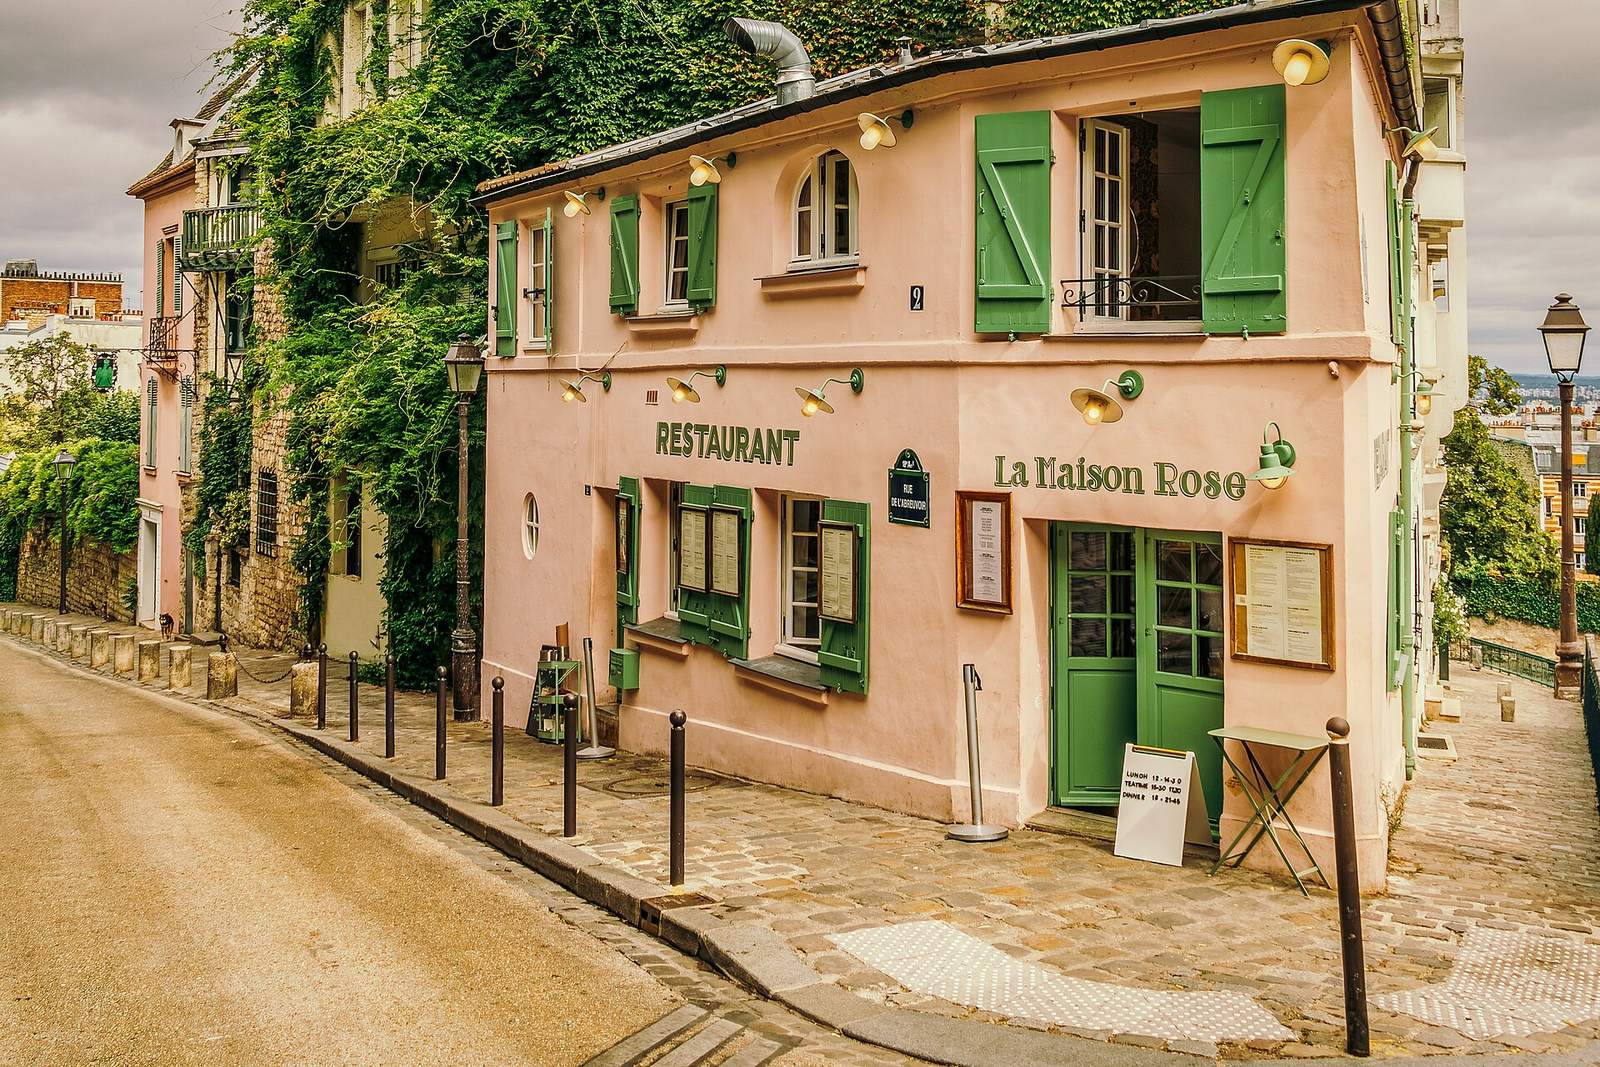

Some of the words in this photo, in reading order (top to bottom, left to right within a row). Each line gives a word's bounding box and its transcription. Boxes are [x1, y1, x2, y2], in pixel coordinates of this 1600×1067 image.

[913, 287, 921, 310] 2
[655, 421, 800, 466] RESTAURANT
[903, 483, 913, 494] RUE
[994, 454, 1029, 488] La
[1034, 456, 1145, 494] Maison
[1153, 461, 1247, 501] Rose
[1122, 791, 1145, 801] DINNER
